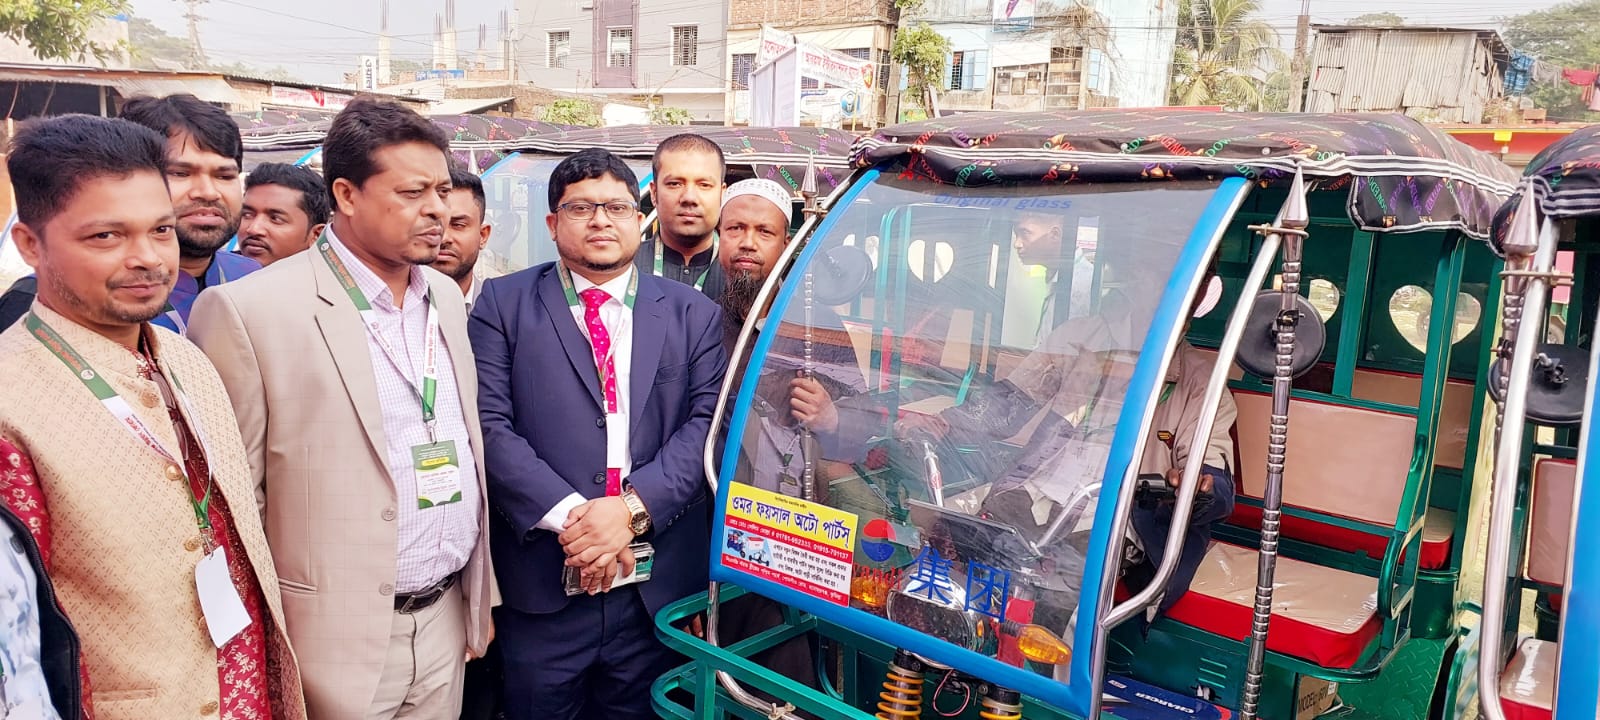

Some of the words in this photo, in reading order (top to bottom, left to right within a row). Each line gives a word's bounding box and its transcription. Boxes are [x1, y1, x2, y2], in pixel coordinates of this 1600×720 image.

[1015, 197, 1073, 210] glass
[732, 497, 753, 514] ওমর
[757, 502, 790, 526] ফয়সাল
[794, 511, 819, 534] অটো
[909, 546, 1011, 624] 集团
[1135, 692, 1195, 714] CHARGER
